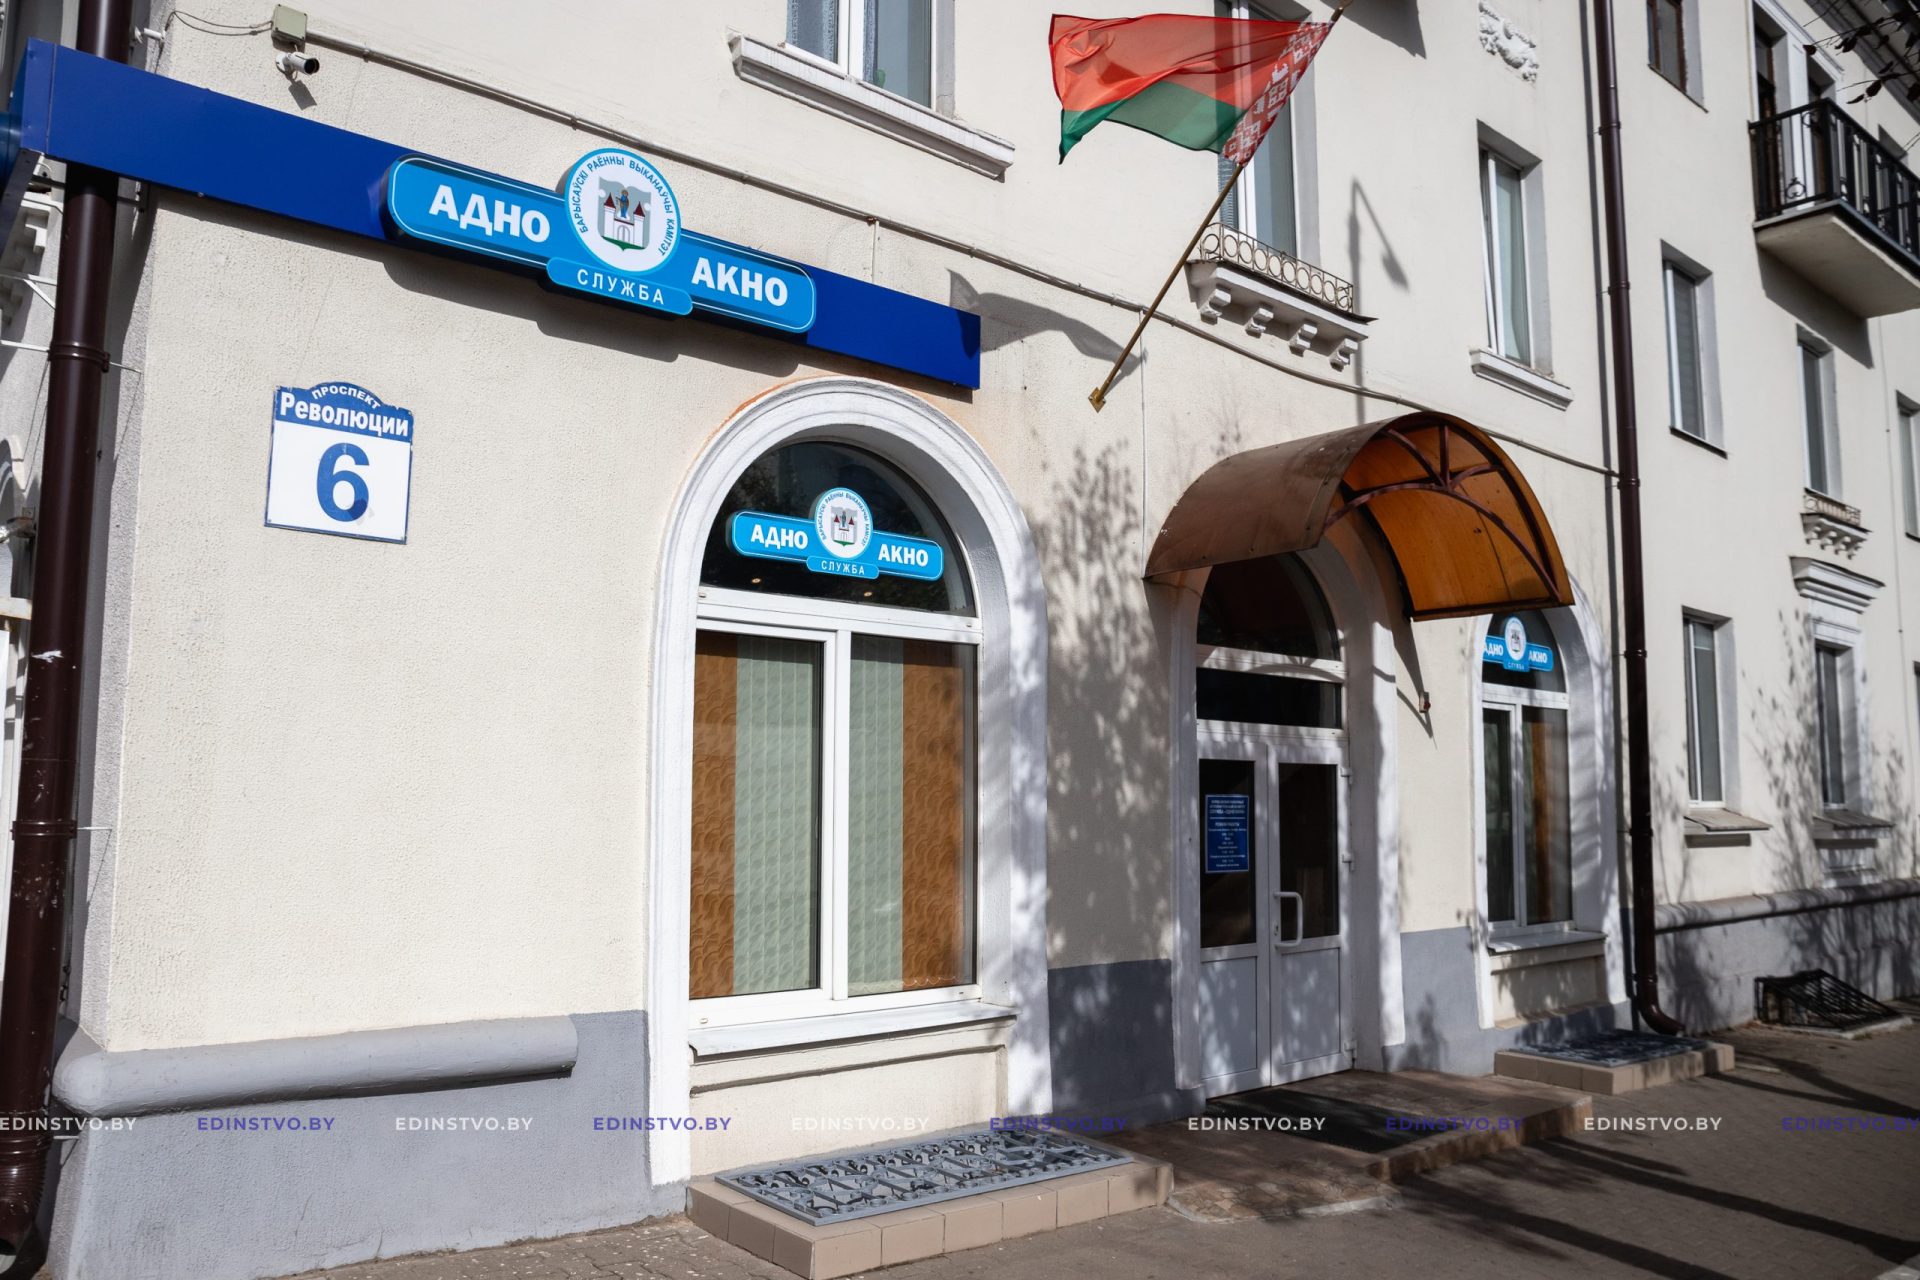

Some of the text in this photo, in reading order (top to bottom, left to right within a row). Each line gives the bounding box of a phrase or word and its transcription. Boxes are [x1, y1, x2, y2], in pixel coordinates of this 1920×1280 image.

[572, 155, 675, 257] БАРЫСАЎСКІ РАЁННЫ ВЫКАНАЎЧЫ КАМІТЭТ
[428, 184, 788, 308] АДНО АКНО
[577, 268, 665, 305] СЛУЖБА
[280, 392, 408, 437] Революции
[312, 385, 382, 410] ПРОСПЕКТ
[316, 442, 370, 522] 6
[750, 524, 929, 567] АДНО АКНО
[821, 559, 866, 575] СЛУЖБА
[1528, 650, 1548, 664] АКНО
